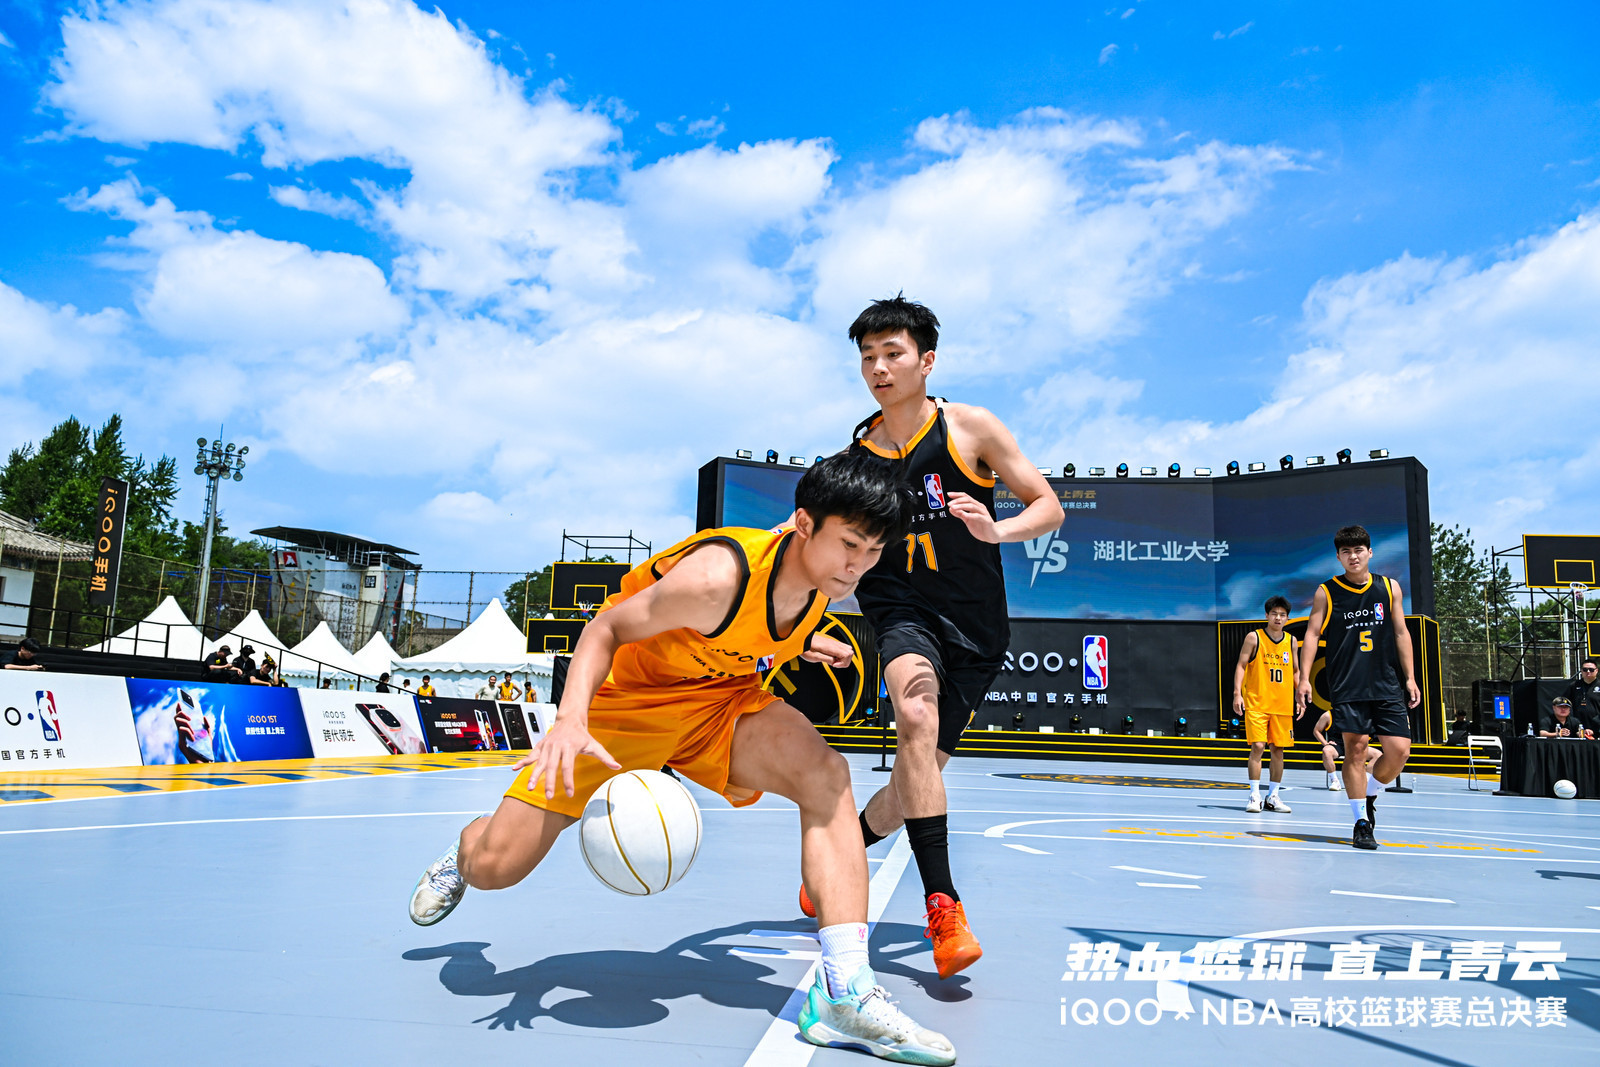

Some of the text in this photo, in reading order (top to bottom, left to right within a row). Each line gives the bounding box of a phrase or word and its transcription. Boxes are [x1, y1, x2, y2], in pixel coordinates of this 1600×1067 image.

[1093, 540, 1229, 562] 湖北工业大学
[1359, 630, 1374, 652] 5
[1269, 668, 1283, 683] 10
